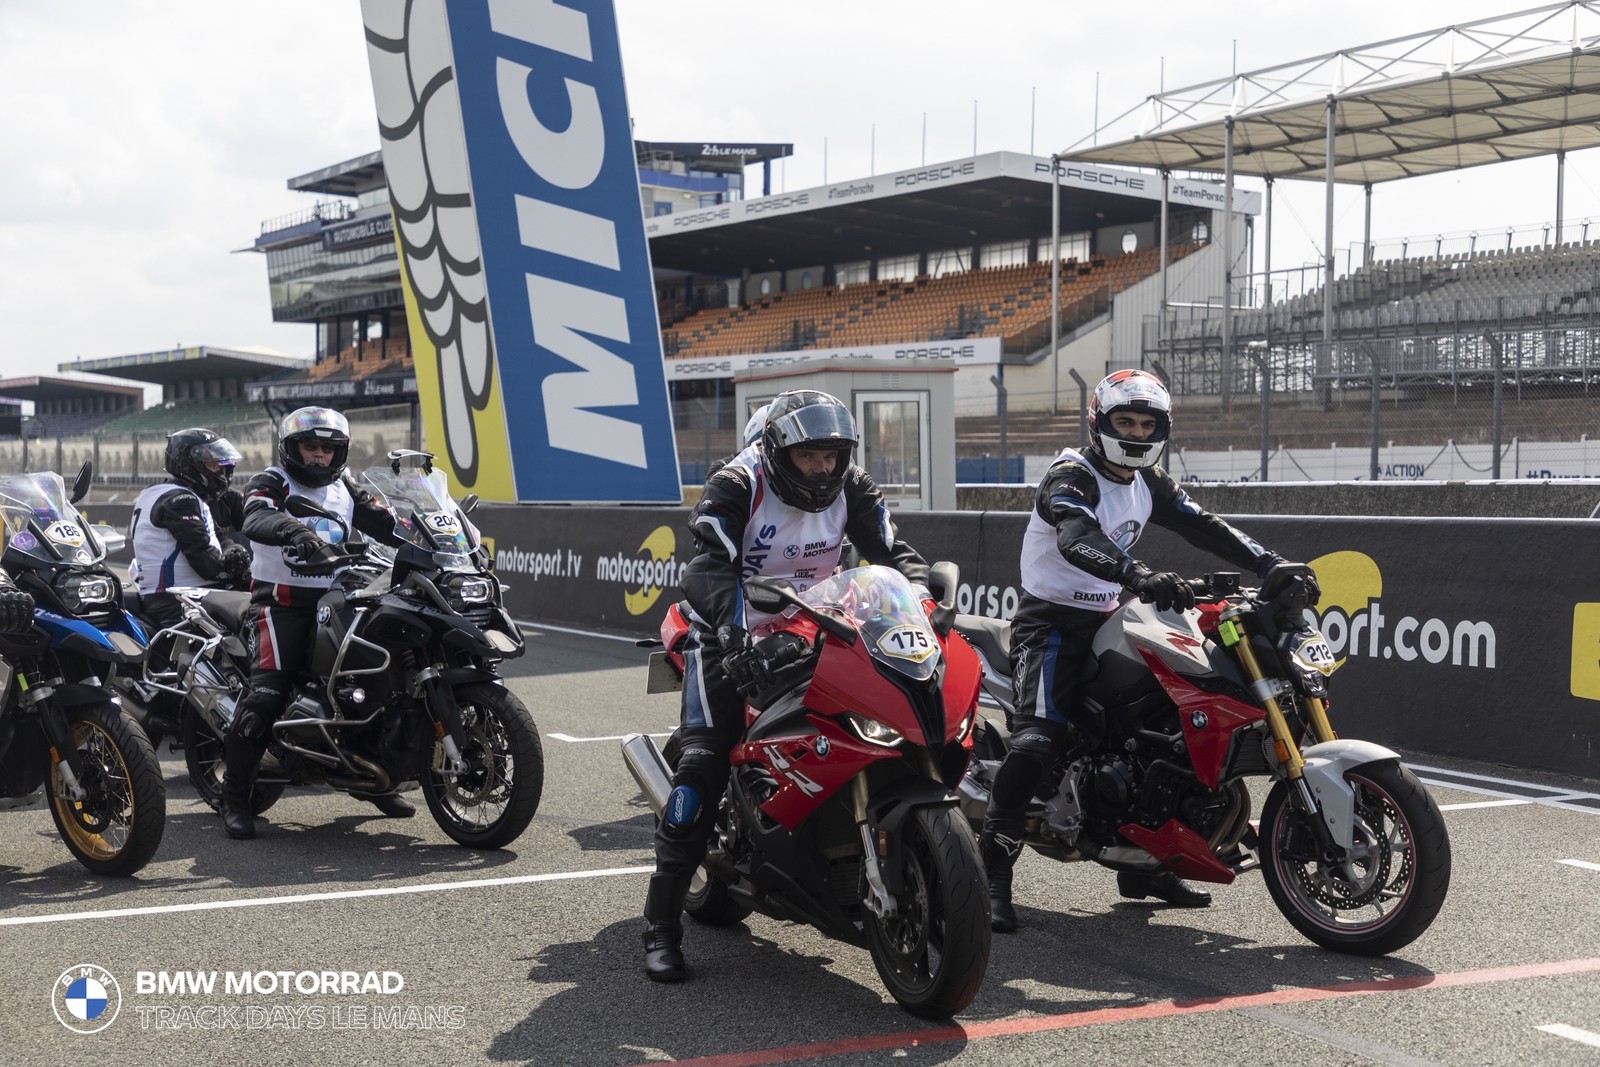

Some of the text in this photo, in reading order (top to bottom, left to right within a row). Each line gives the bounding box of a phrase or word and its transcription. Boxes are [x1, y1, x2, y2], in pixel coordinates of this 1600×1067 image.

[731, 148, 757, 156] MANS
[894, 162, 975, 188] PORSCHE
[1034, 162, 1145, 190] PORSCHE
[828, 182, 874, 200] #TeamPorsche
[1172, 184, 1233, 203] #TeamPorsc
[745, 193, 809, 215] PORSCHE
[673, 208, 730, 228] PORSCHE
[333, 221, 376, 244] AUTOMOBILE
[895, 345, 975, 360] PORSCHE
[675, 361, 731, 374] PORSCHE
[1385, 464, 1425, 477] ACTION
[434, 515, 458, 528] 204
[55, 525, 81, 538] 186
[804, 541, 827, 551] BMW
[1069, 543, 1118, 565] RST
[496, 545, 582, 582] motorsport.tv
[1073, 591, 1107, 602] BMW
[890, 631, 928, 650] 175
[1306, 644, 1332, 662] 212
